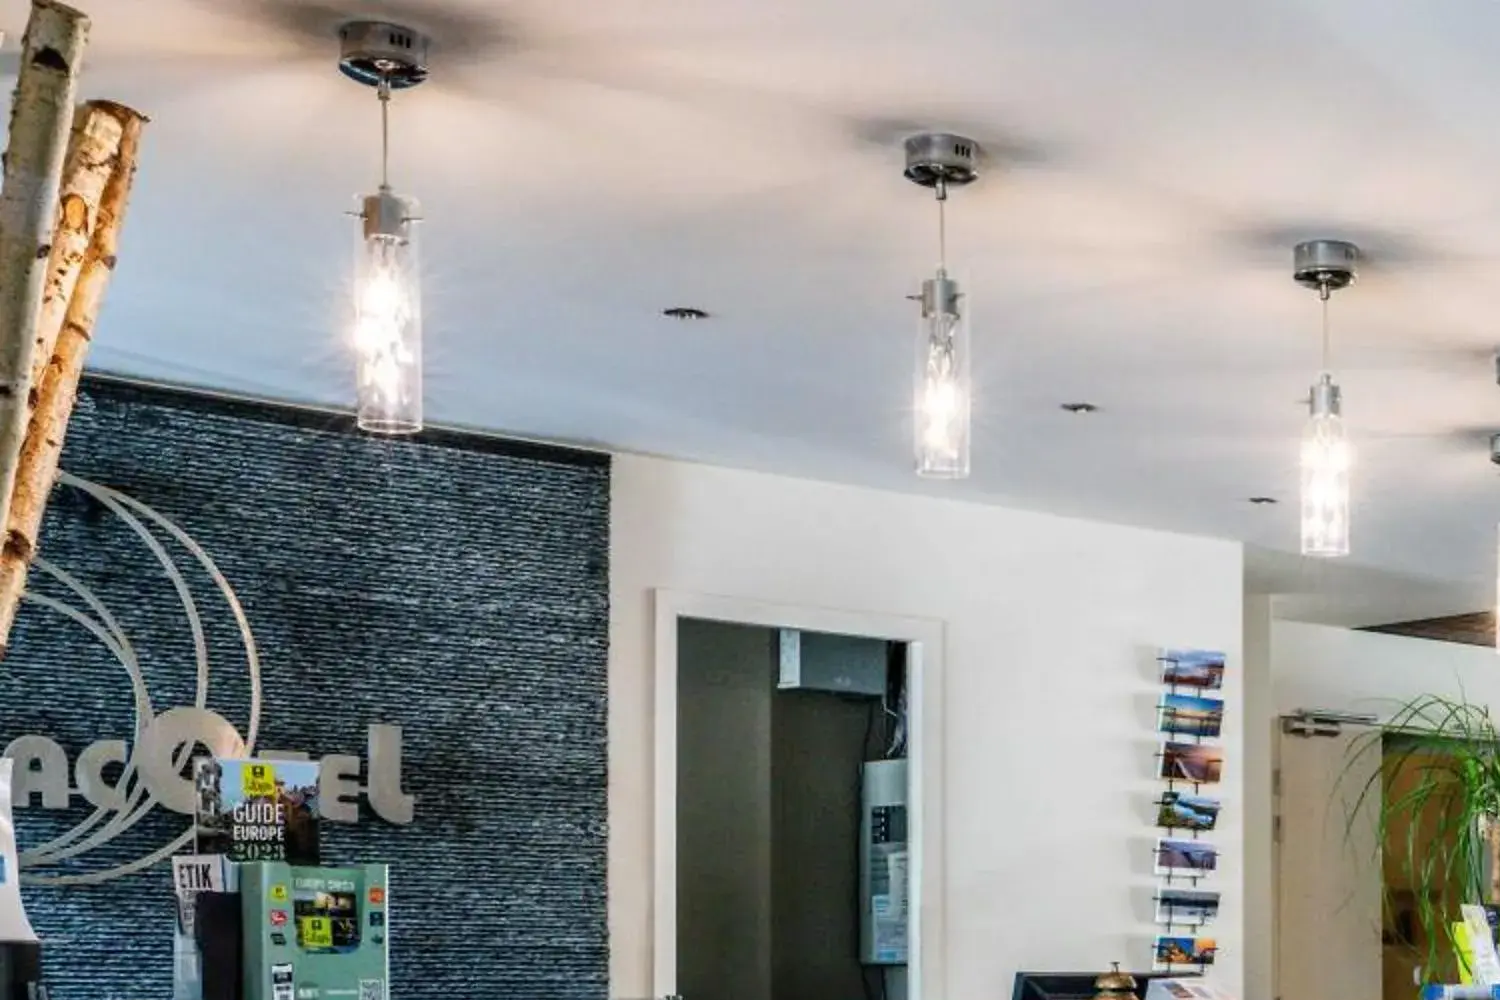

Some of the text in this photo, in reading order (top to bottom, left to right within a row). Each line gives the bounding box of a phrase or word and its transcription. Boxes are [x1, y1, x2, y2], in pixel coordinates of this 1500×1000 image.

[233, 803, 285, 824] GUIDE
[233, 825, 285, 841] EUROPE
[179, 863, 212, 889] ETIK
